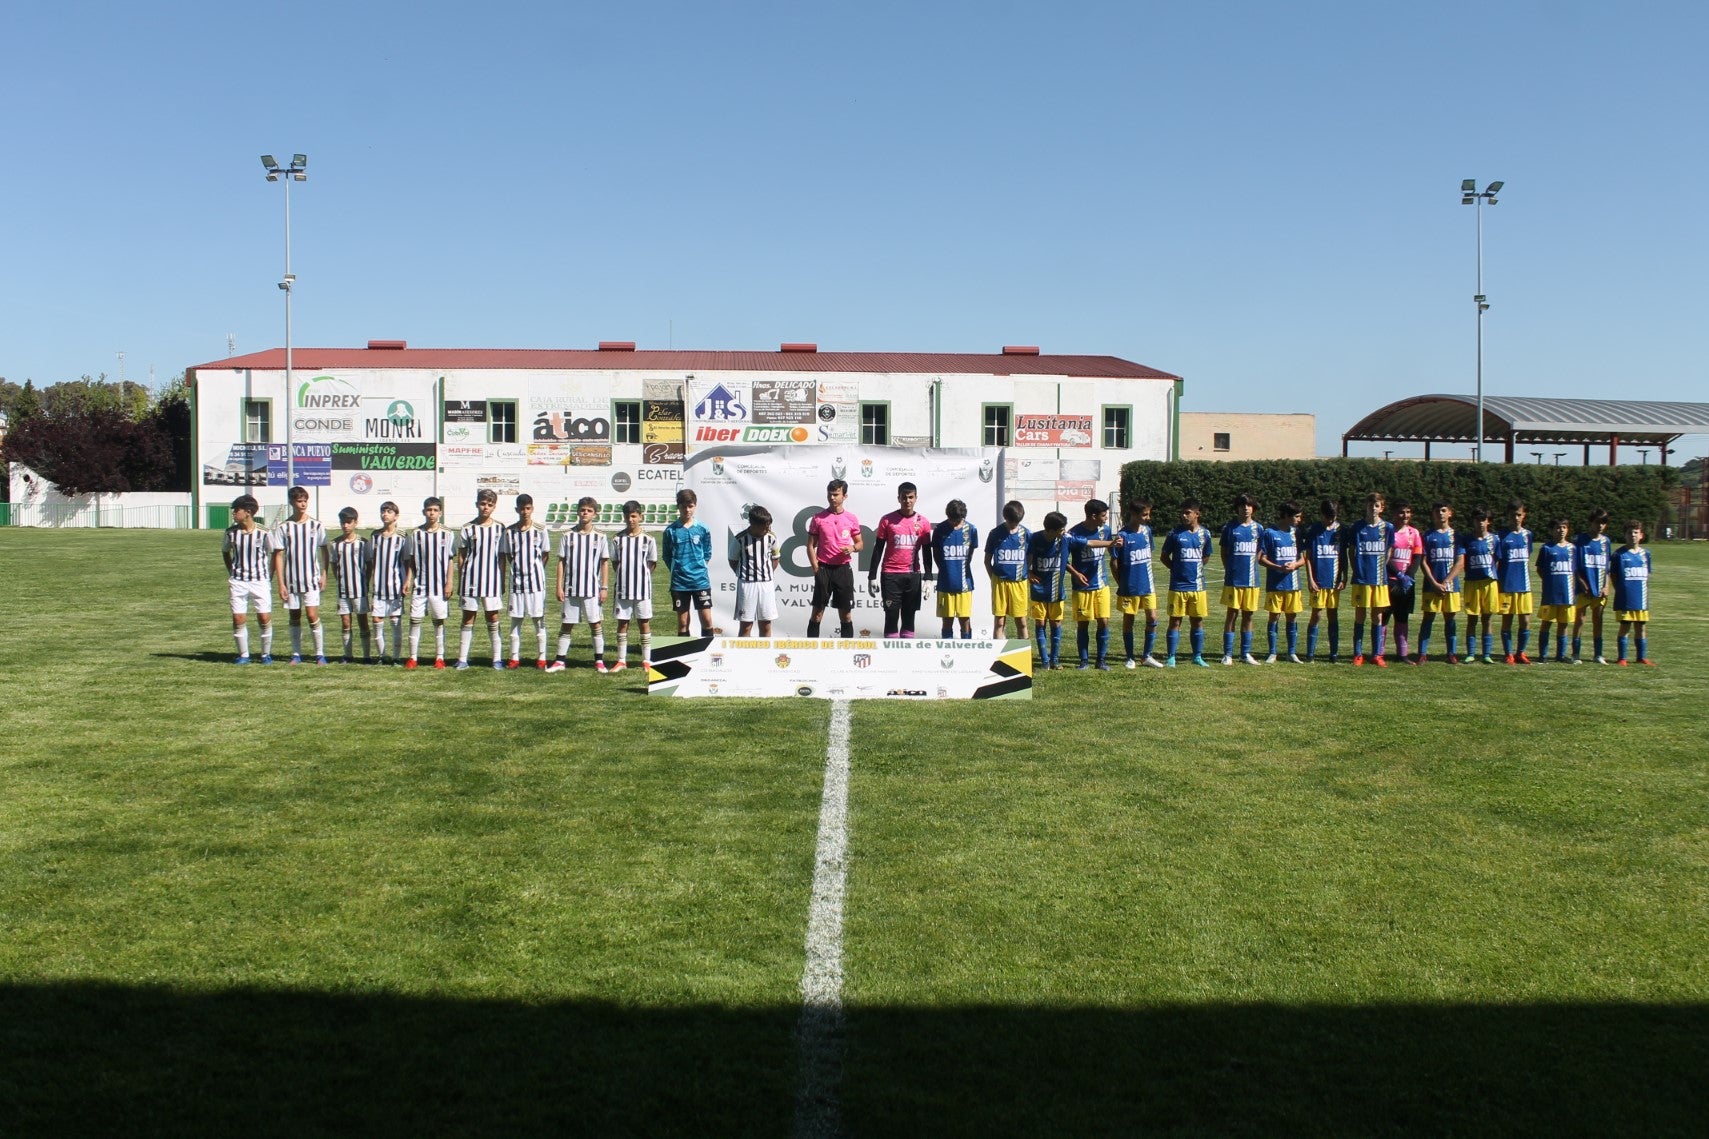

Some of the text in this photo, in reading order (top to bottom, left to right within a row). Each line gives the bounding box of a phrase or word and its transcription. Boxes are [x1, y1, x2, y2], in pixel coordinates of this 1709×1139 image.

[774, 381, 815, 389] DELICADO
[304, 394, 360, 408] INPREX
[294, 419, 353, 430] CONDE
[533, 411, 610, 440] ático
[1016, 415, 1092, 429] Lusitania
[365, 418, 422, 438] MONRI
[695, 426, 789, 441] iber DOEX
[1015, 429, 1049, 441] Cars
[281, 446, 331, 456] BNCA PUEYO
[332, 443, 396, 455] Suministros
[361, 455, 435, 470] VALVERDE
[1233, 541, 1257, 552] SOHO
[1276, 547, 1297, 557] SOHO
[1359, 541, 1385, 552] SOHO
[998, 549, 1025, 561] SOHO
[1130, 549, 1151, 562] SOHO
[1508, 548, 1528, 559] SOHO
[1585, 554, 1606, 564] SOHO
[1624, 567, 1648, 577] SOHO
[729, 640, 771, 649] TORNEO
[774, 639, 818, 649] IBÉRICO
[821, 640, 835, 649] DE
[883, 640, 911, 649] Villa
[916, 640, 932, 649] de
[935, 641, 993, 649] Valverde
